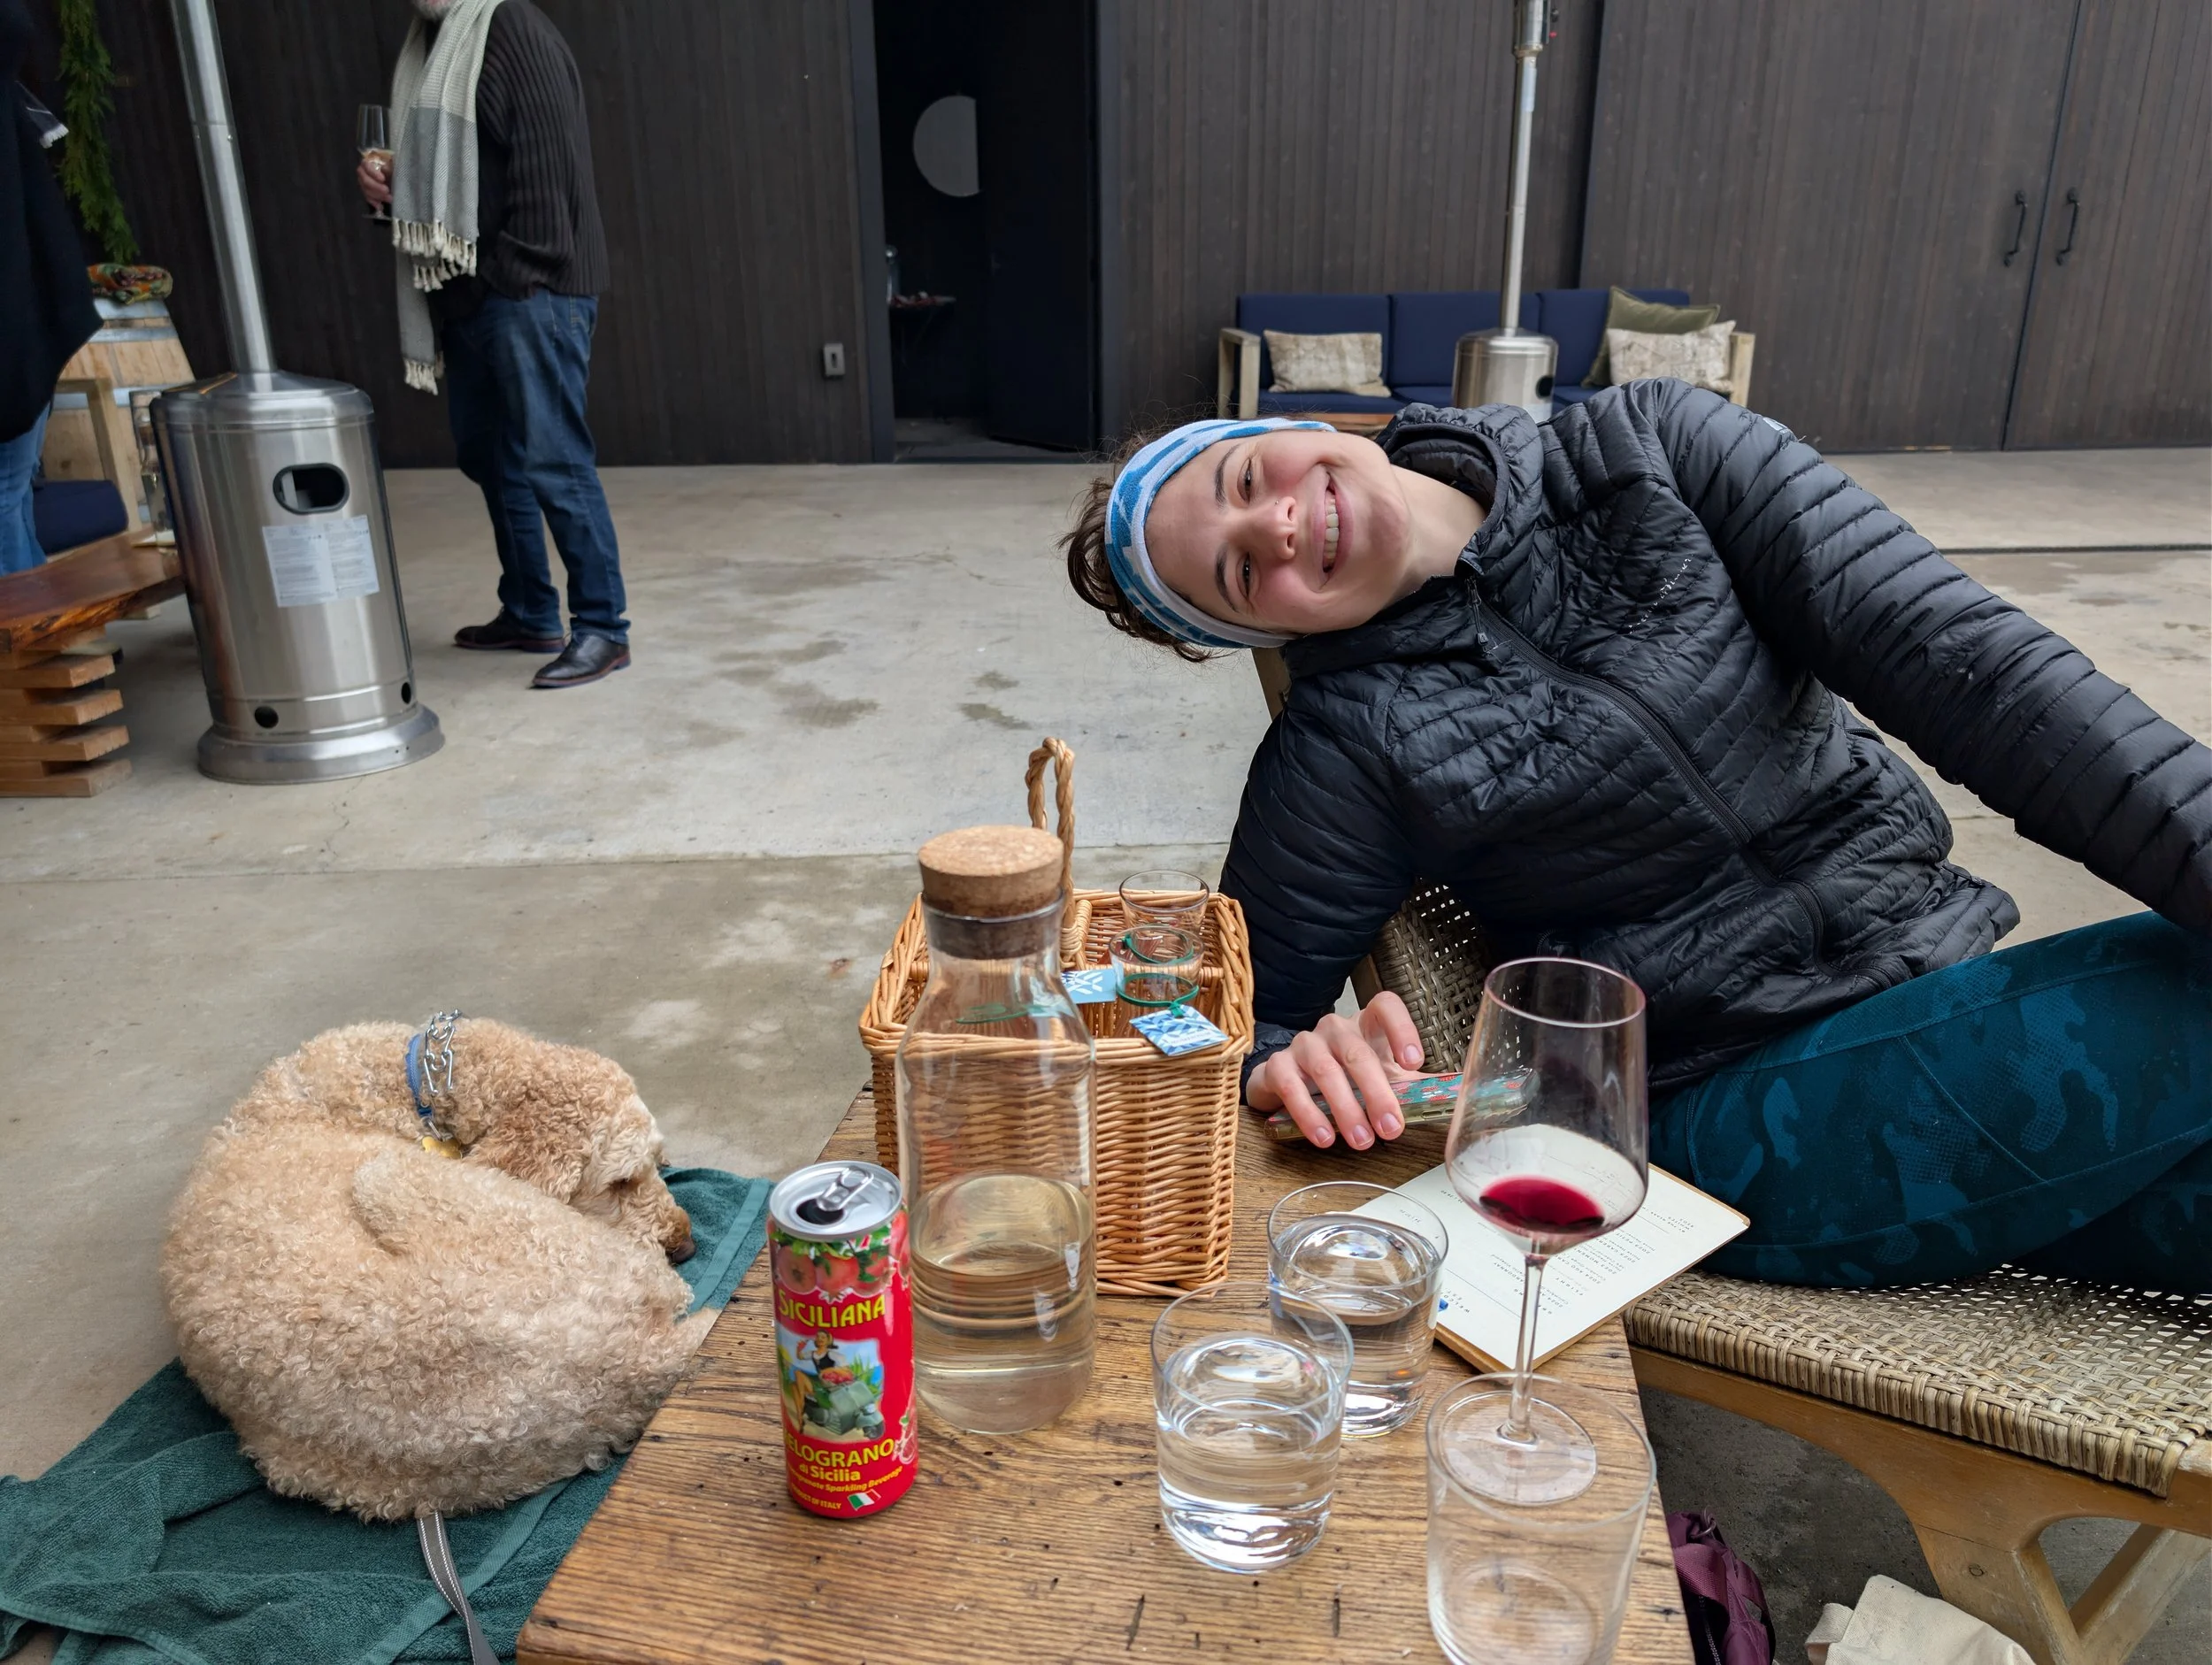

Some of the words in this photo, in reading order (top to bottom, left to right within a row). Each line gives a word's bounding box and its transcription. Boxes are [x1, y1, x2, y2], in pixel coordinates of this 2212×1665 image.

[779, 1289, 886, 1328] SICILIANA
[1441, 1292, 1470, 1313] WELCO
[810, 1465, 861, 1482] Sicilia
[825, 1481, 867, 1493] Sparkling
[867, 1465, 902, 1488] Beverage
[820, 1499, 841, 1510] ITALY
